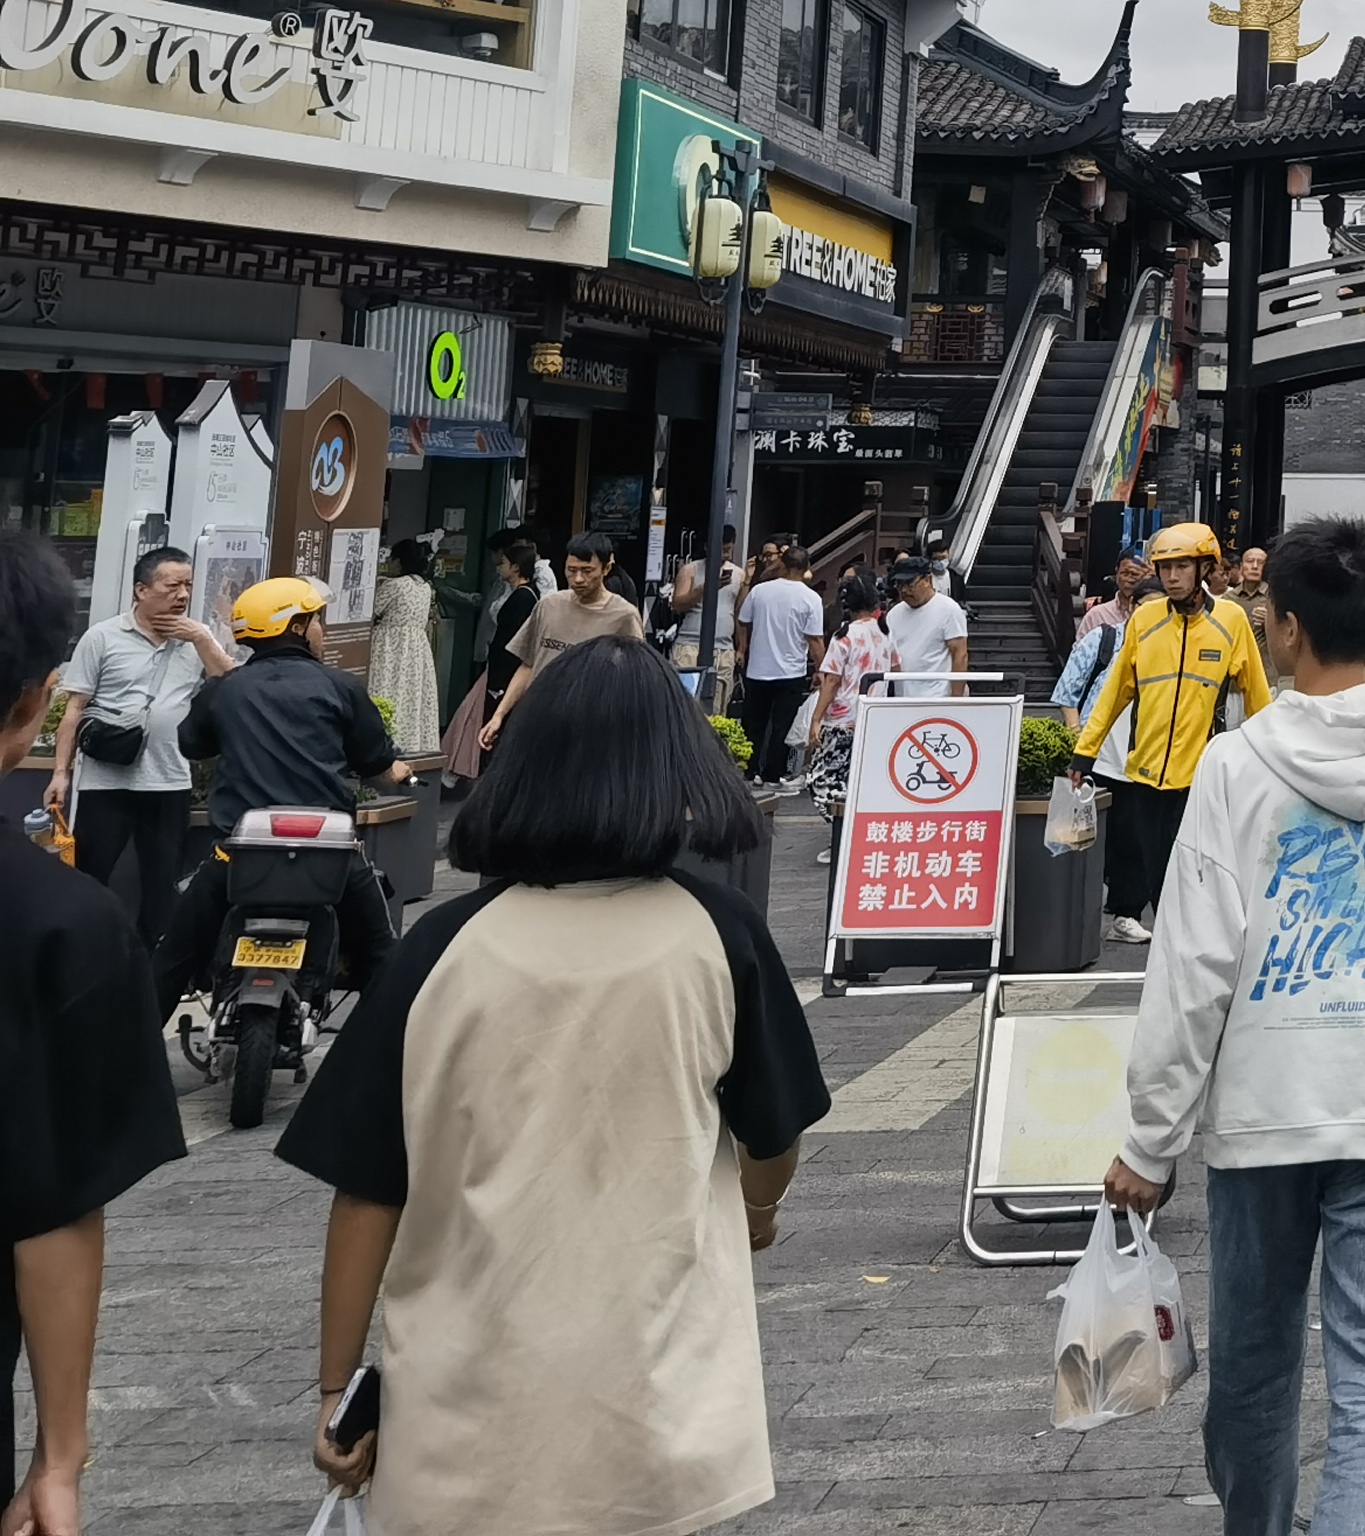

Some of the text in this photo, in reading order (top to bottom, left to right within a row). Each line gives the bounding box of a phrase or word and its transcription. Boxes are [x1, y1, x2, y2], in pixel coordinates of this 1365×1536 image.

[781, 222, 878, 298] TREE&HOME
[865, 819, 988, 845] 鼓楼步行街
[861, 849, 984, 880] 非机动车
[857, 881, 980, 912] 禁止入内
